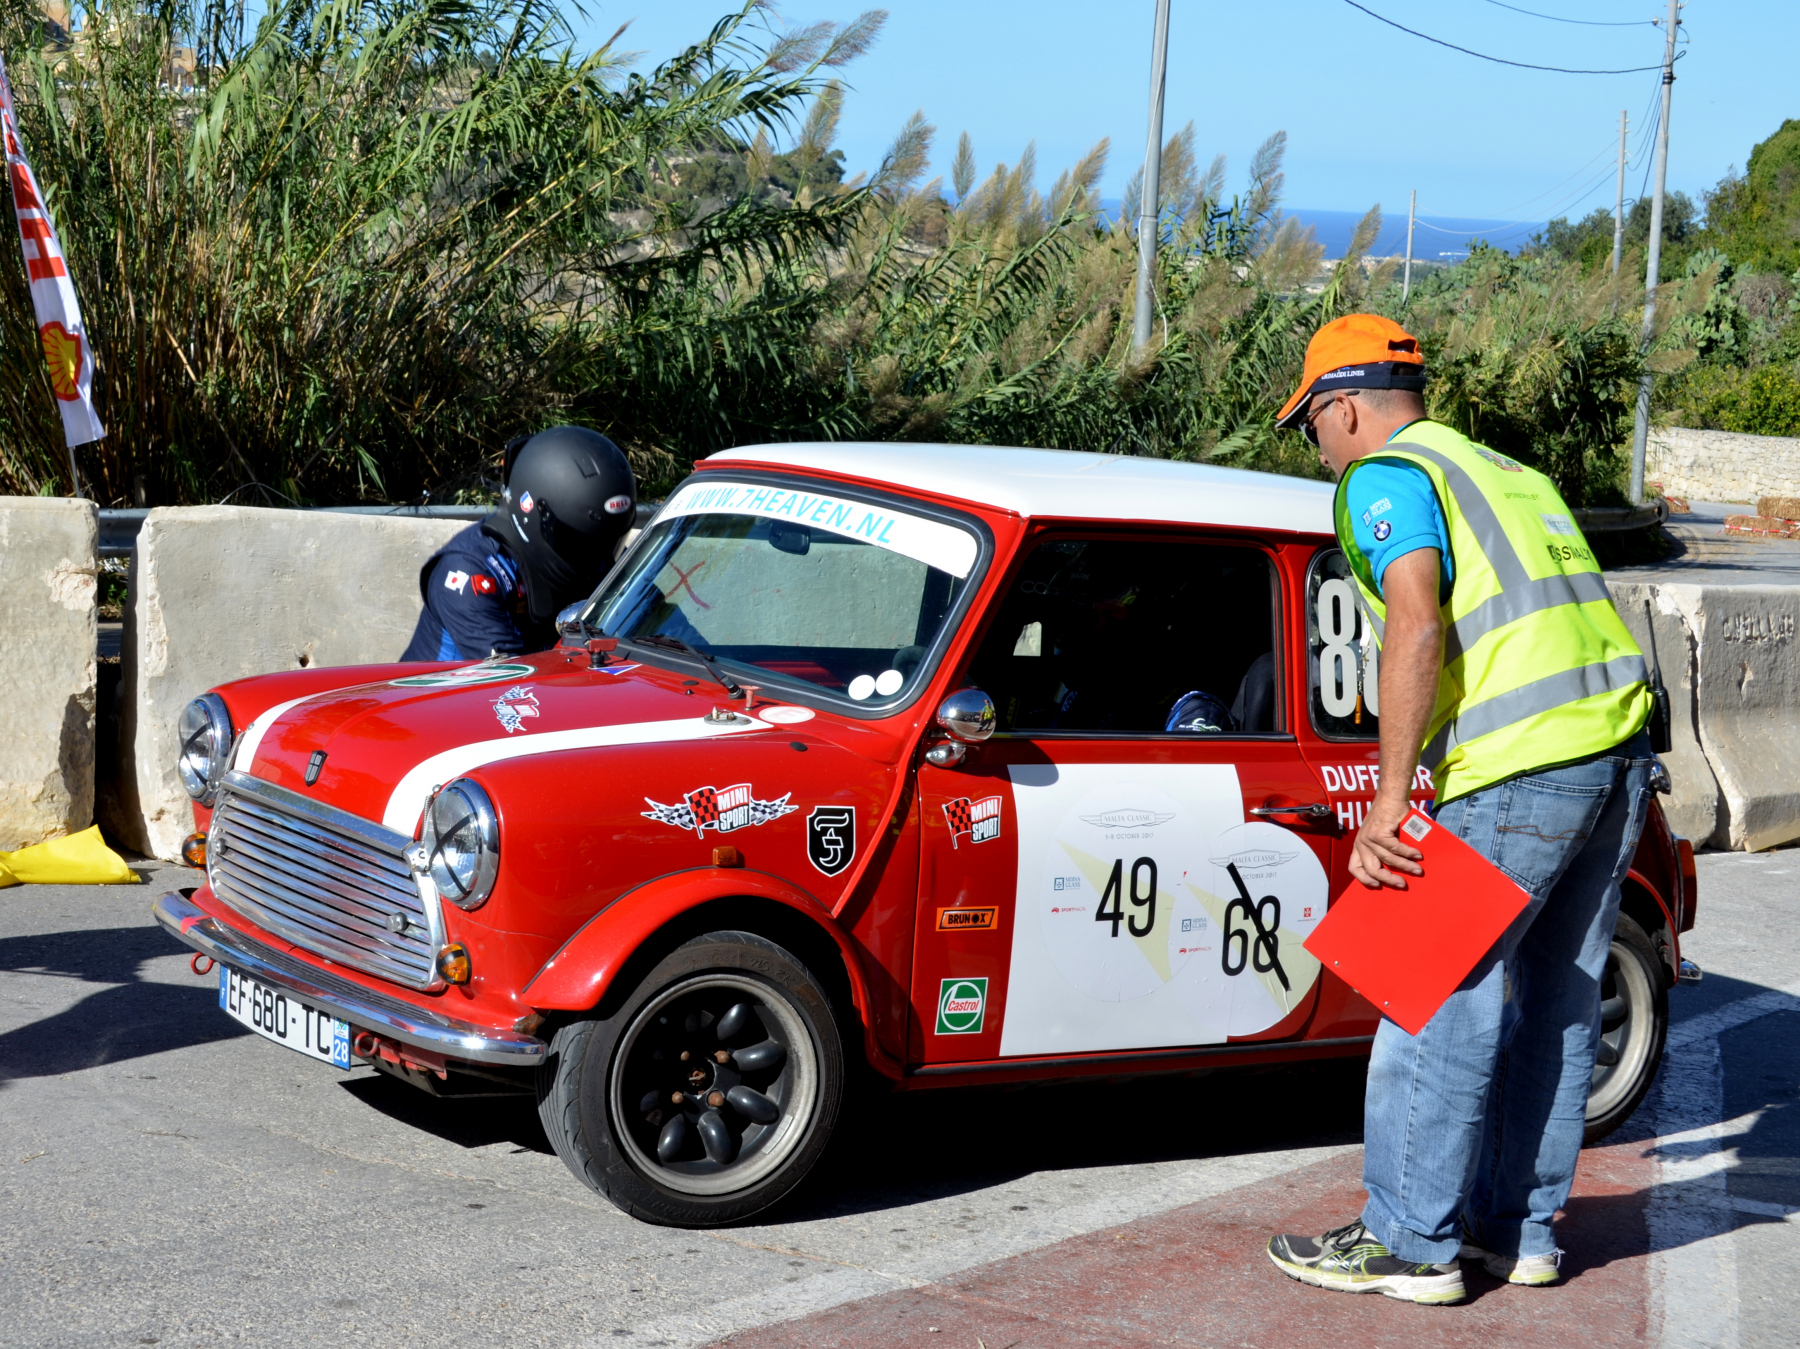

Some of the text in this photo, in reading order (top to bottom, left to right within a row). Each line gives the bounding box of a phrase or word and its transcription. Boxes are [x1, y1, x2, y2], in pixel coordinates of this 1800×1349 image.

[685, 487, 896, 544] WWW.7HEAVEN.NL
[1321, 764, 1436, 792] DUFFR
[716, 787, 748, 812] MINI
[970, 798, 998, 822] MINI
[719, 805, 749, 831] SPORT
[972, 817, 998, 841] SPORT
[1104, 814, 1153, 823] MALTA CLASSIC
[1252, 854, 1277, 863] CLASSIC
[1095, 856, 1158, 938] 49
[228, 969, 331, 1056] EF-680-TC
[947, 999, 980, 1012] Castrol
[333, 1038, 349, 1063] 28
